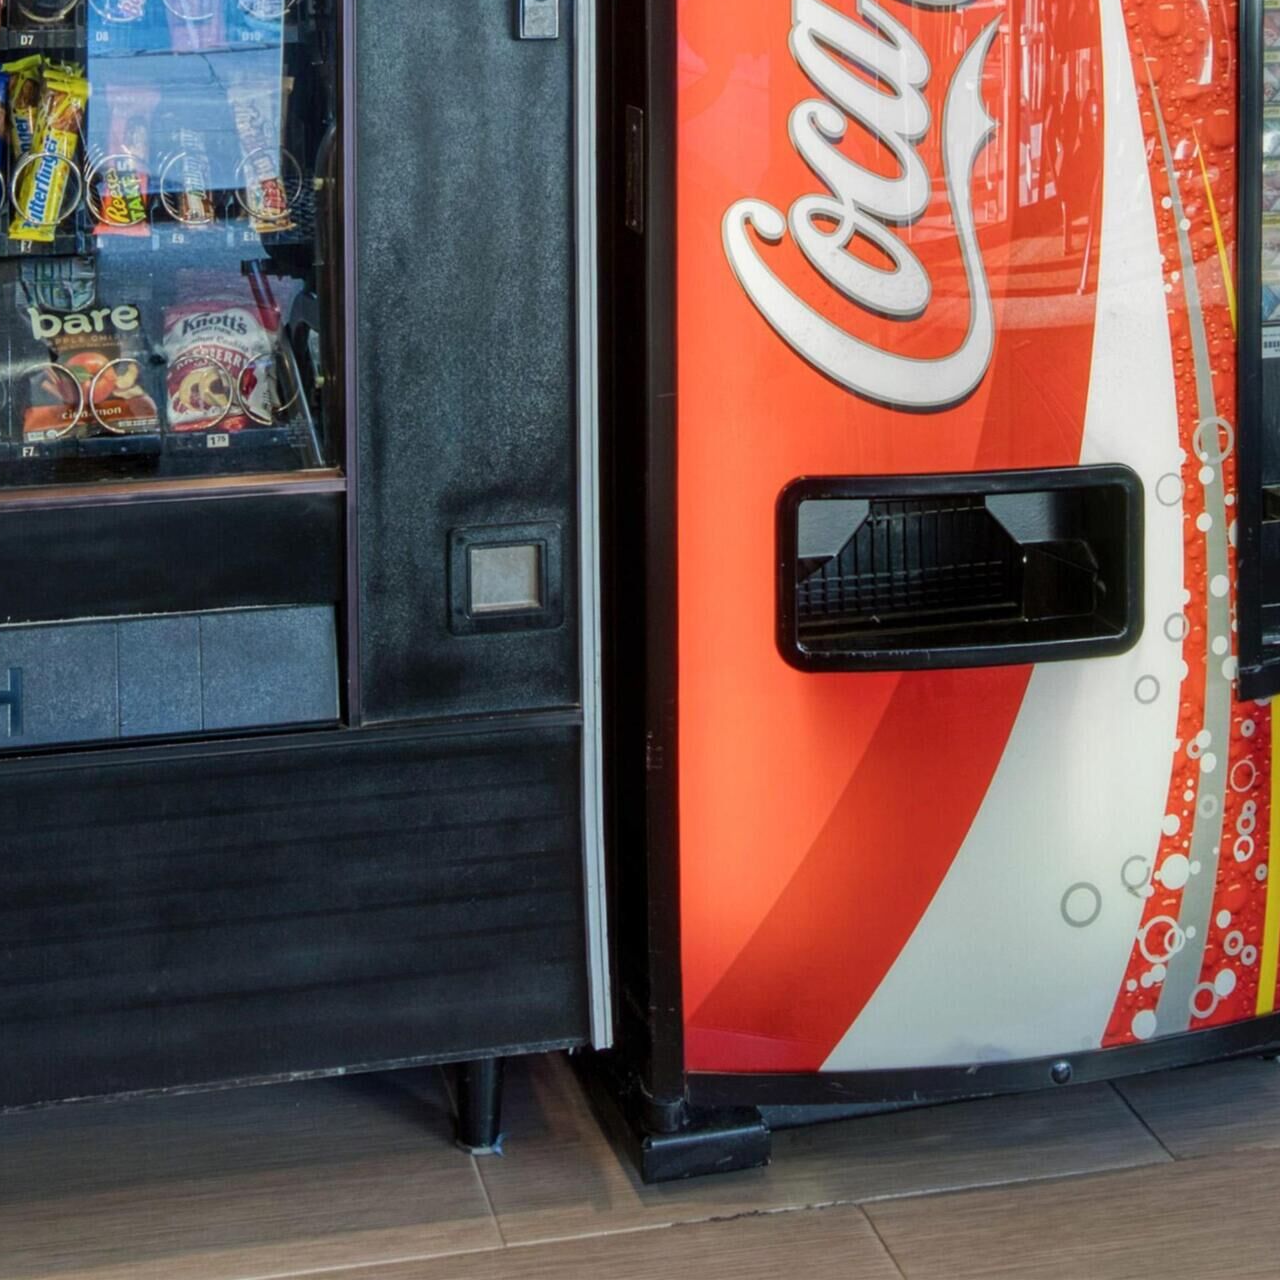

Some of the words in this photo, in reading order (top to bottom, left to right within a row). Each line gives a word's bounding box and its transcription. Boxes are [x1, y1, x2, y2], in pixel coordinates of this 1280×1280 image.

[21, 35, 34, 45] D7
[121, 174, 147, 222] TAKE
[27, 305, 139, 340] bare
[182, 313, 247, 336] Knott's
[22, 446, 34, 457] F7
